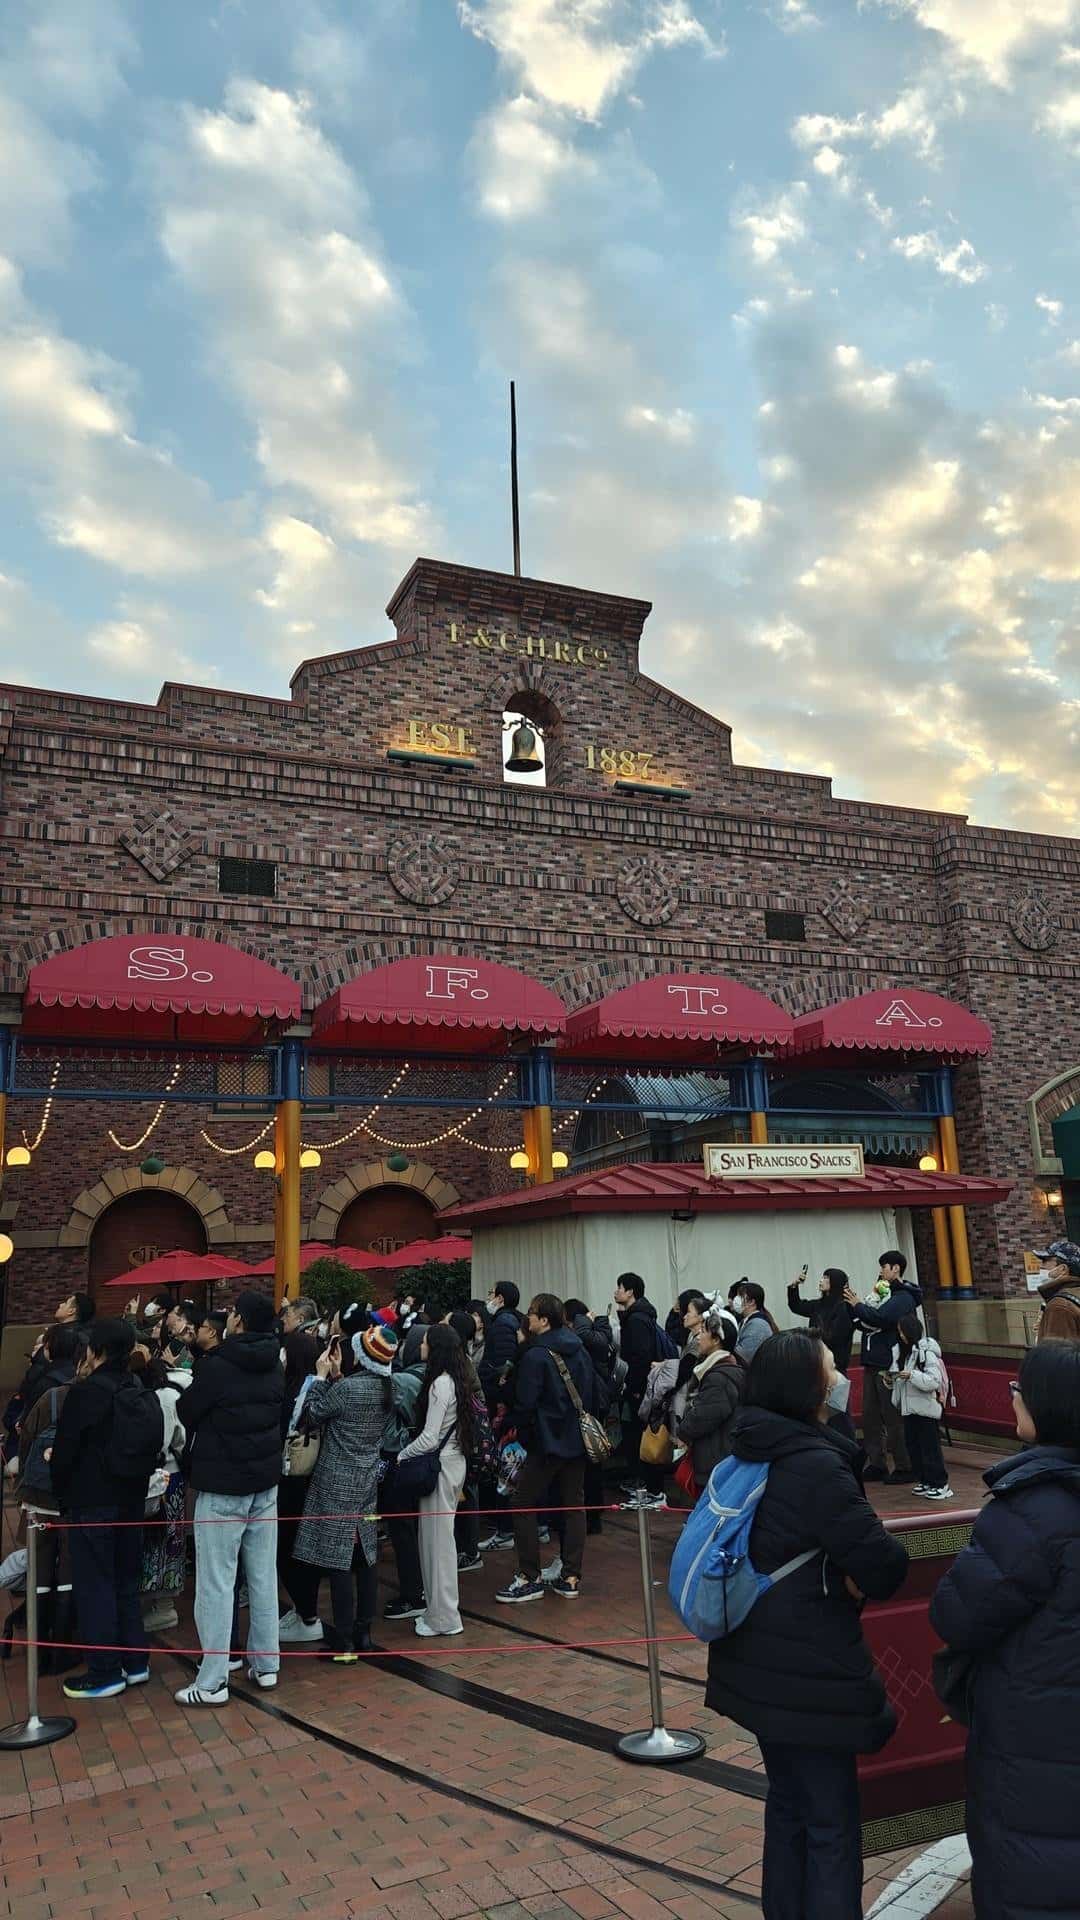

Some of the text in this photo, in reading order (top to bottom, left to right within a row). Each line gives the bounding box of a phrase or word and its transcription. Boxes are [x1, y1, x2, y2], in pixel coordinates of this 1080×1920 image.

[408, 718, 477, 753] EST.
[584, 745, 653, 778] 1887
[127, 946, 943, 1028] S. F. T. A.
